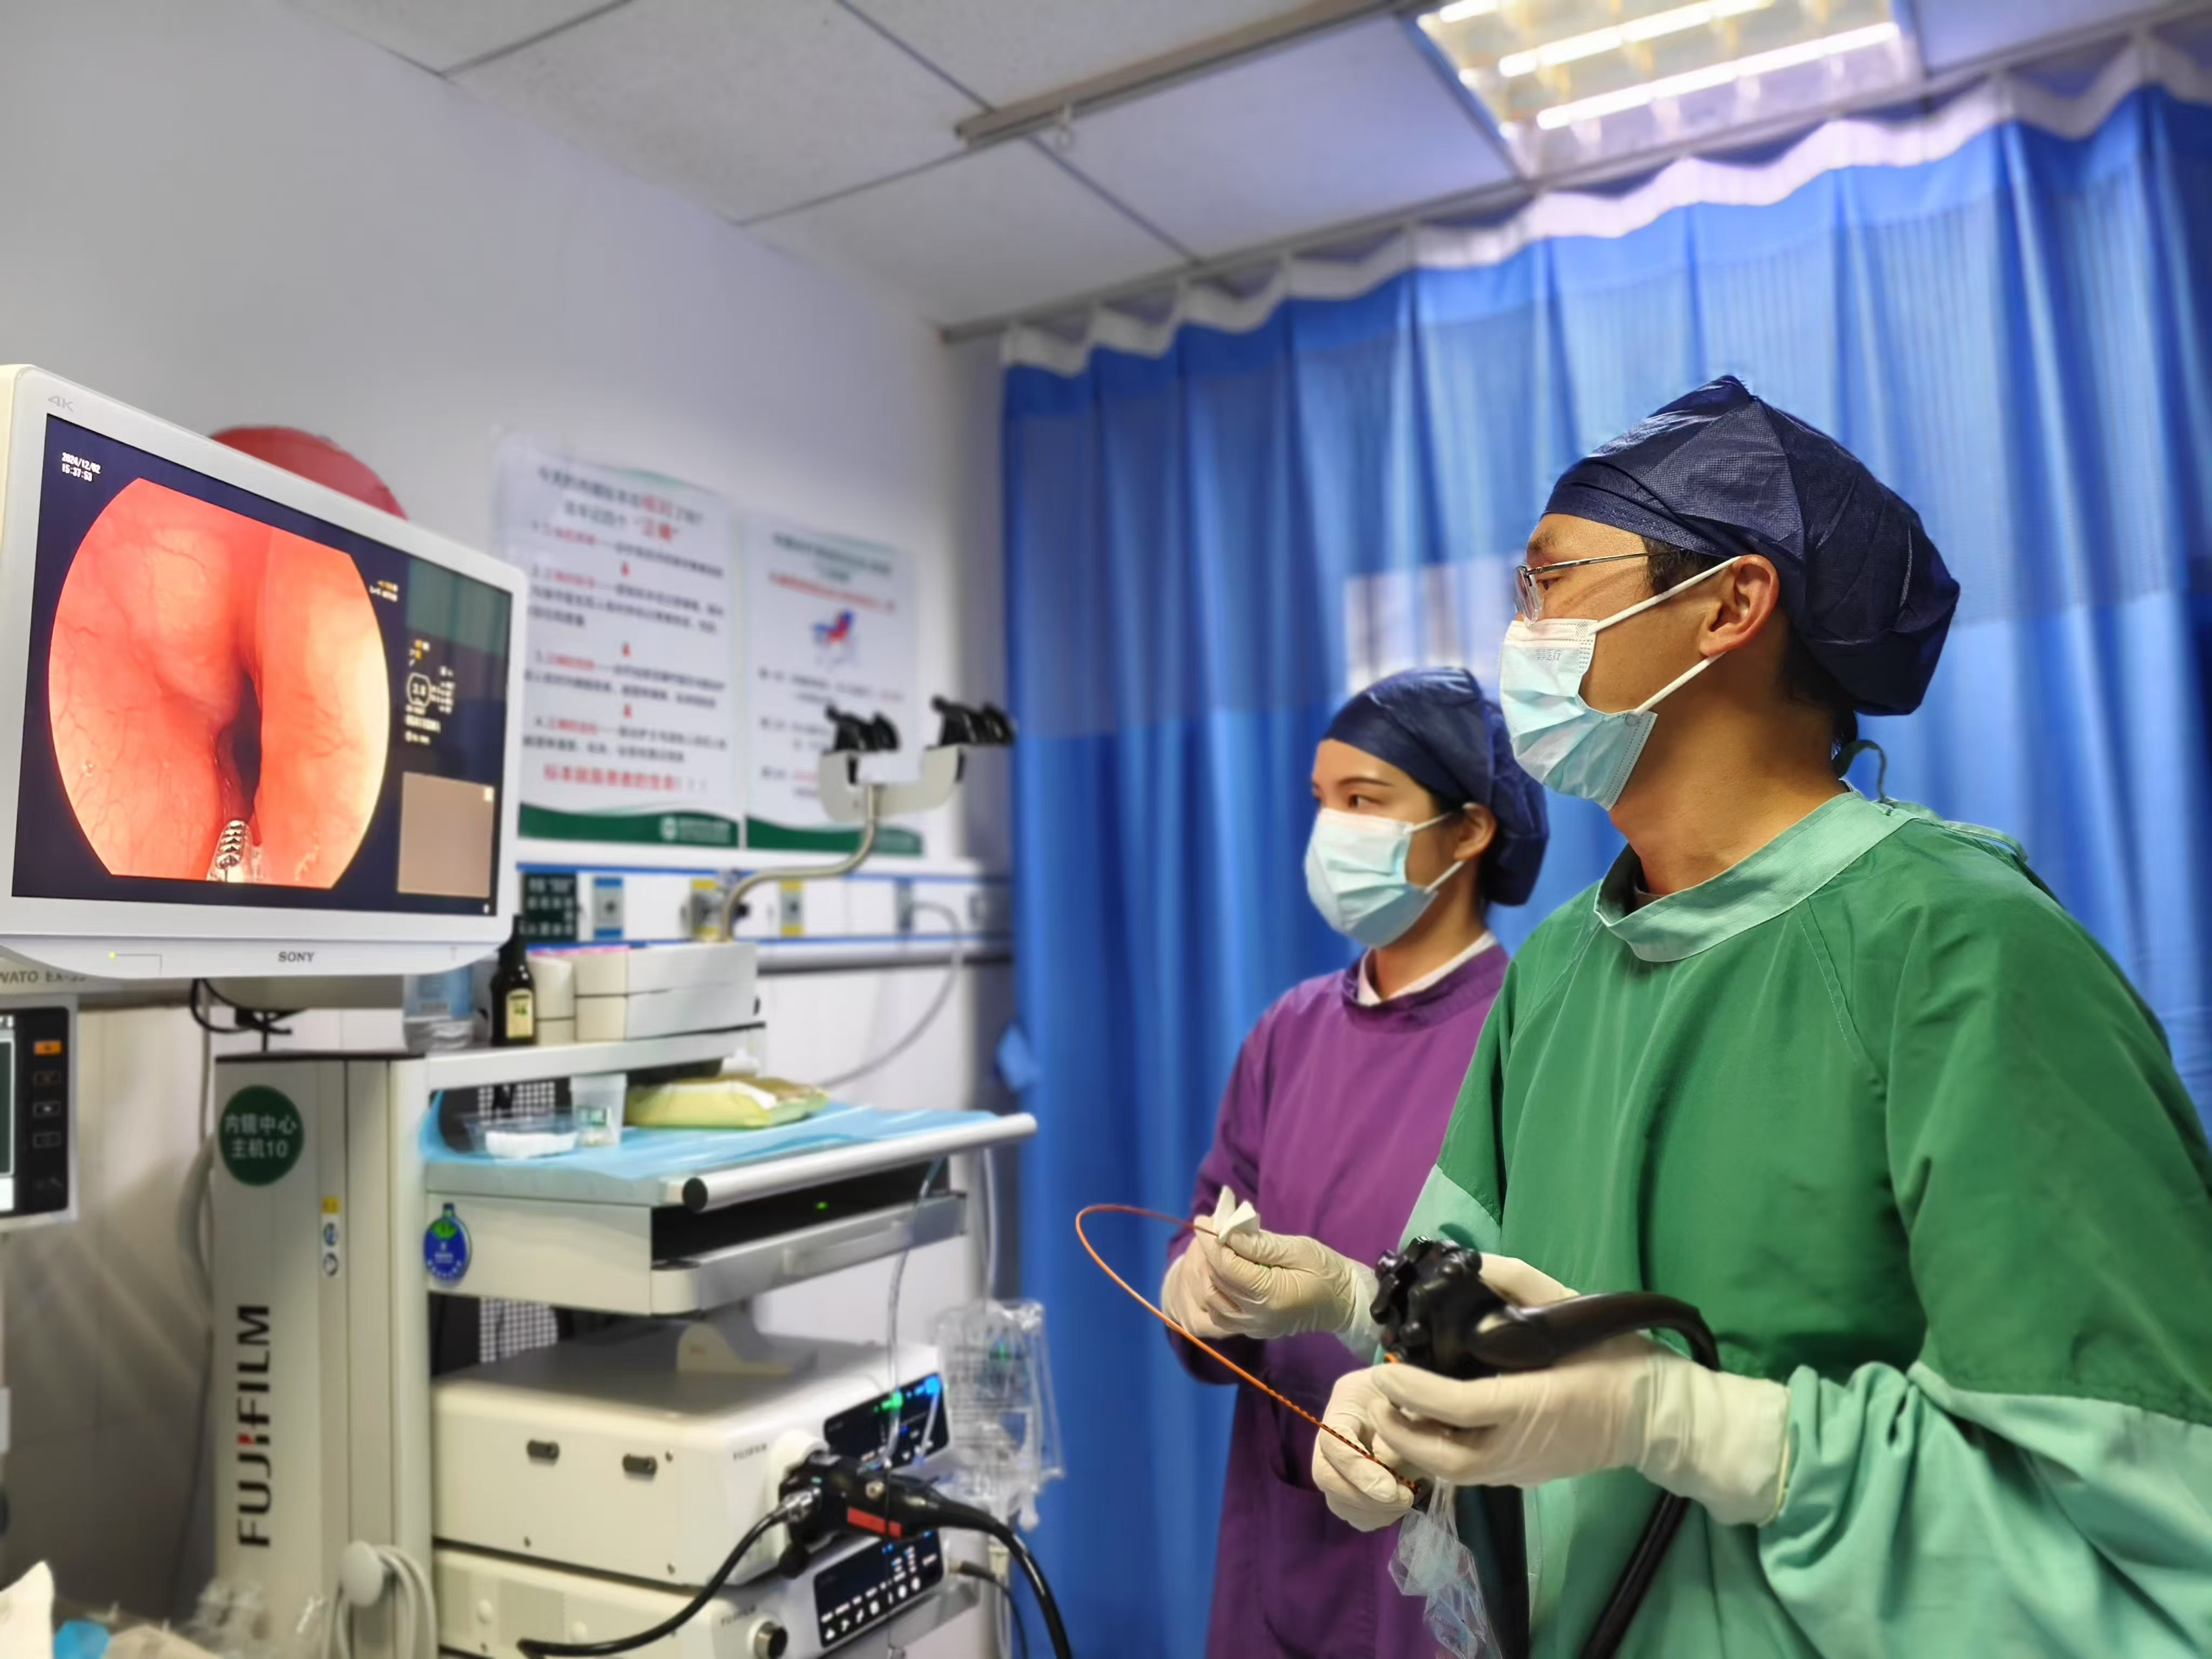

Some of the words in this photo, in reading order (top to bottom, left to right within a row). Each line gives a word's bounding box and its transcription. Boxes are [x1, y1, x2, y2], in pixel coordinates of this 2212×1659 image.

[48, 396, 74, 413] 4K
[62, 452, 101, 474] 2024/12/02
[278, 951, 315, 962] SONY
[225, 1113, 297, 1135] 内镜中心
[232, 1138, 288, 1158] 主机10
[237, 1305, 271, 1548] FUJIFILM
